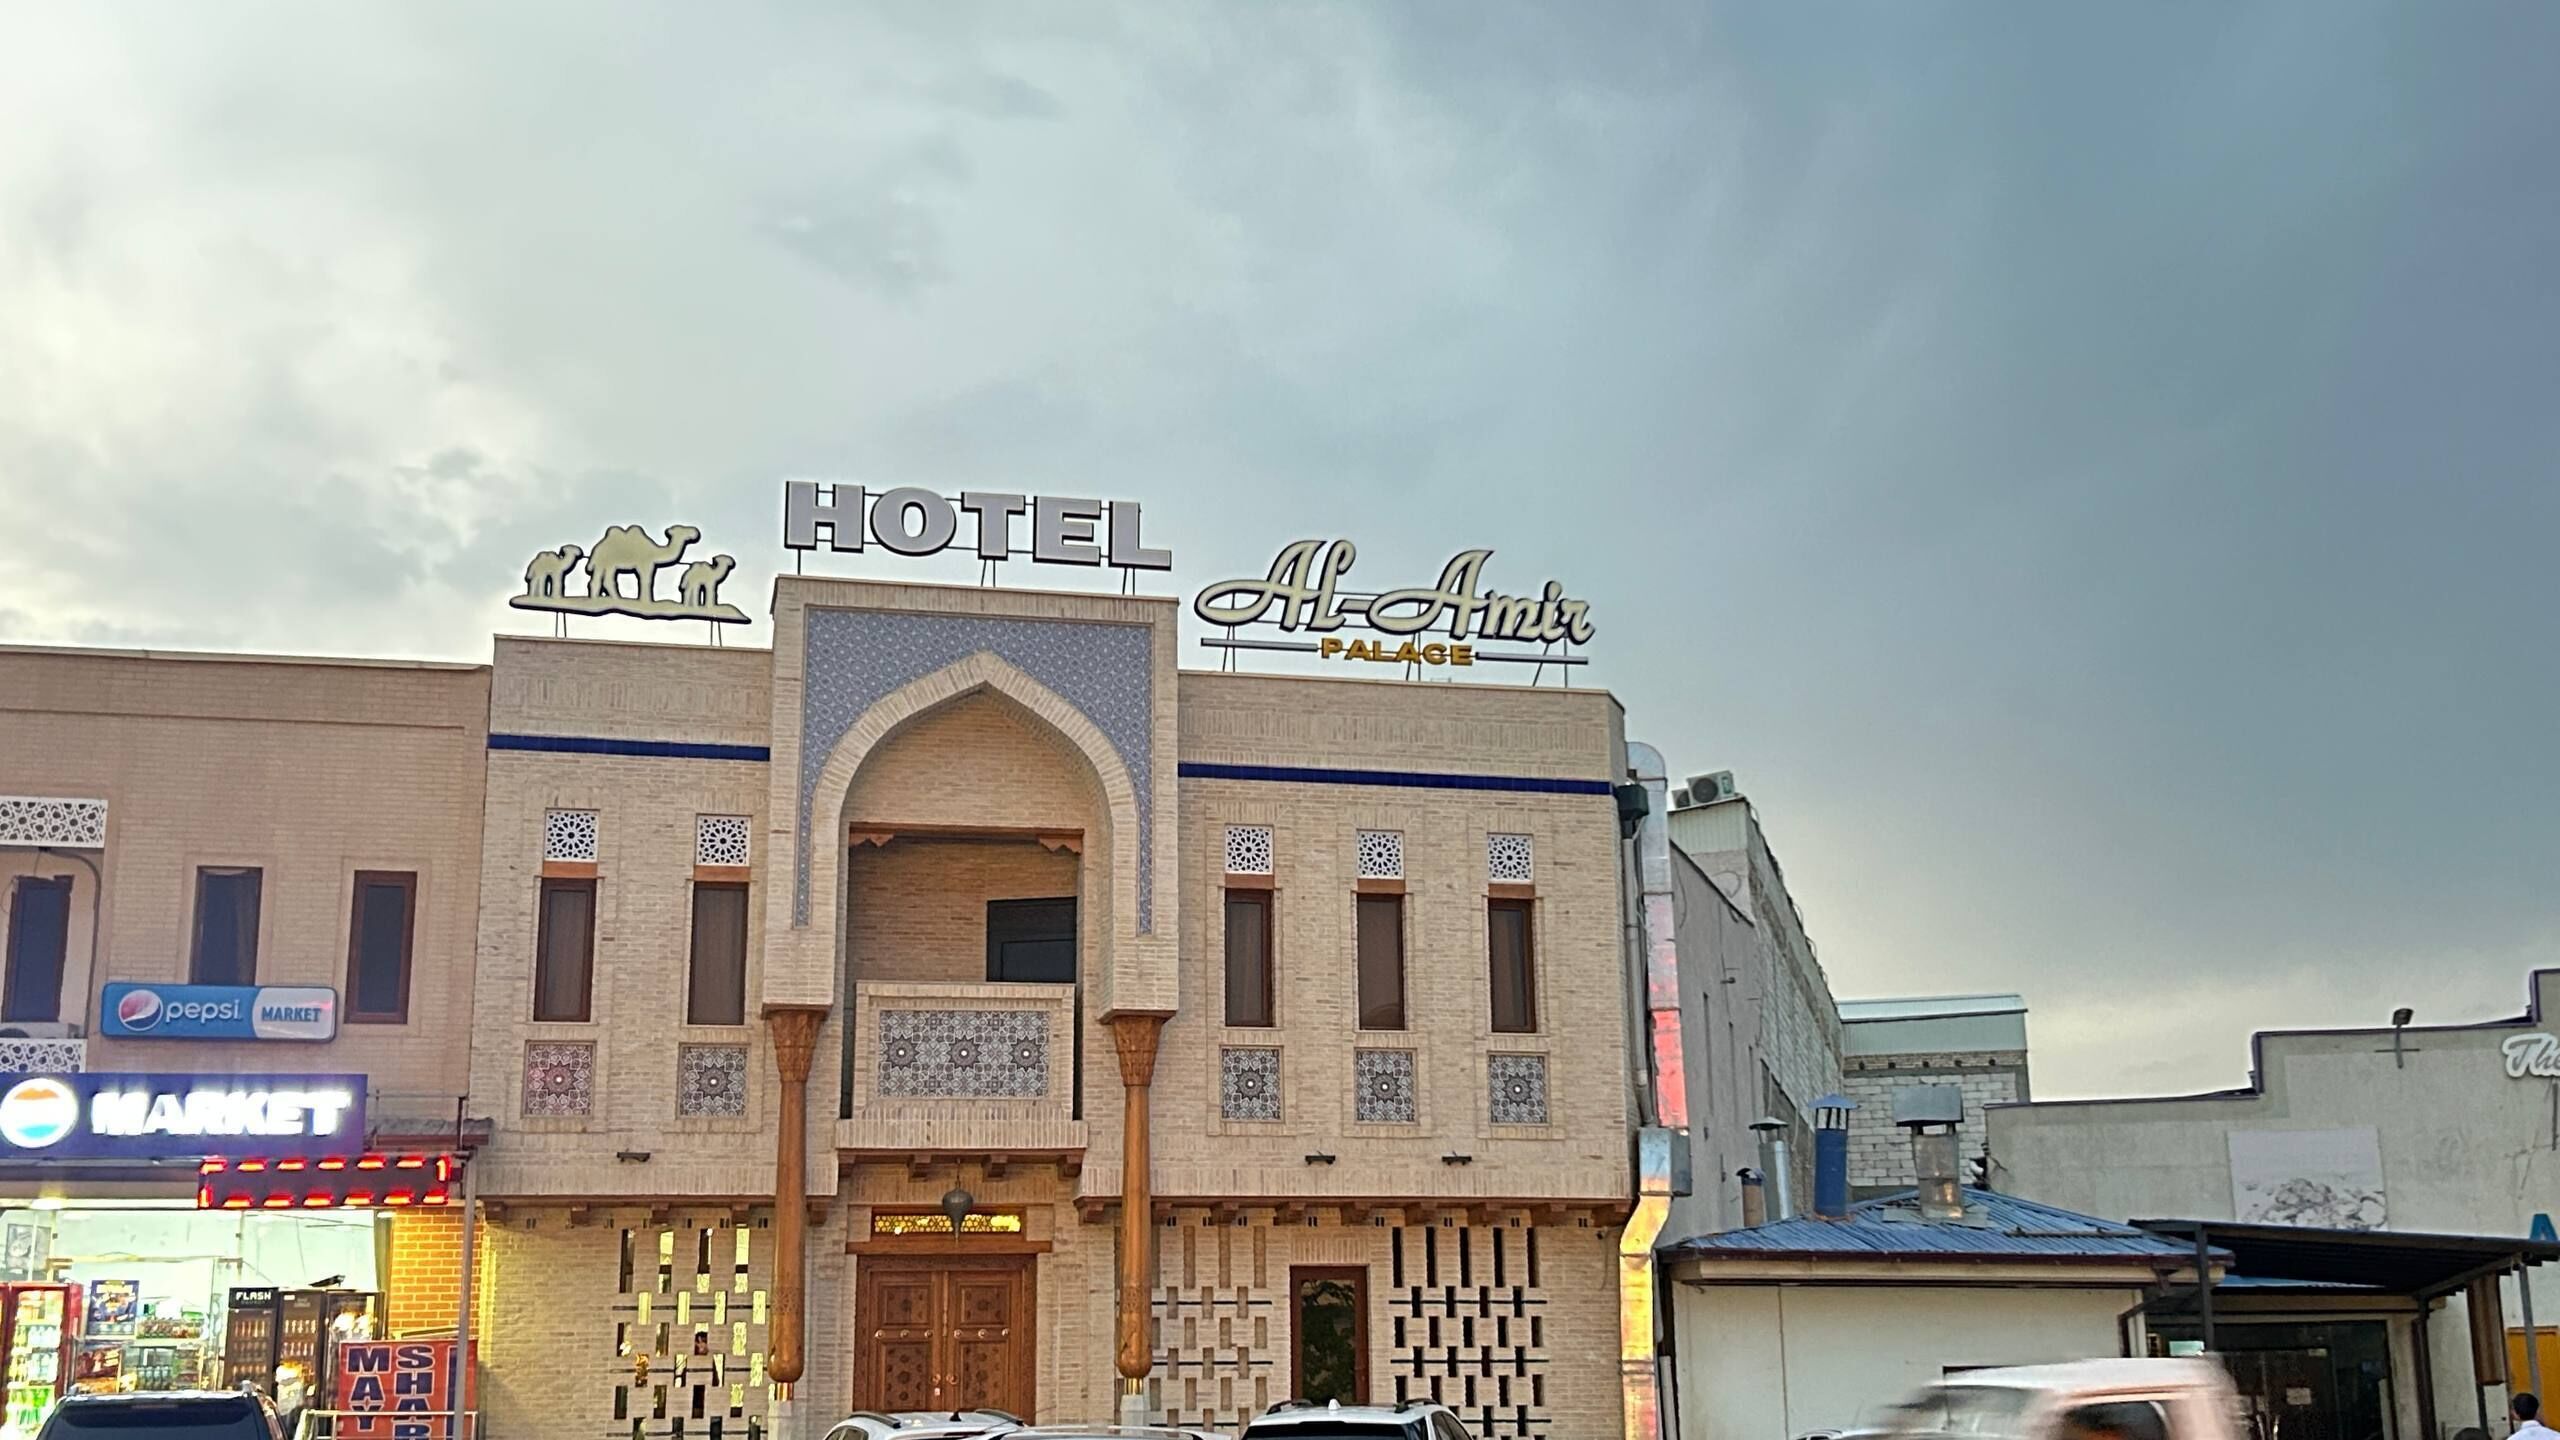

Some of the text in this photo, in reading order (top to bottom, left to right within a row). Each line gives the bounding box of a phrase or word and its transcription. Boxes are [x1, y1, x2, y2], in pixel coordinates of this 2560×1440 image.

[784, 480, 1172, 571] HOTEL
[1194, 539, 1596, 645] Al-Amir
[1321, 637, 1474, 666] PALACE
[165, 999, 323, 1024] pepsi MARKET
[91, 1091, 351, 1136] MARKET
[235, 1291, 272, 1301] FLASH
